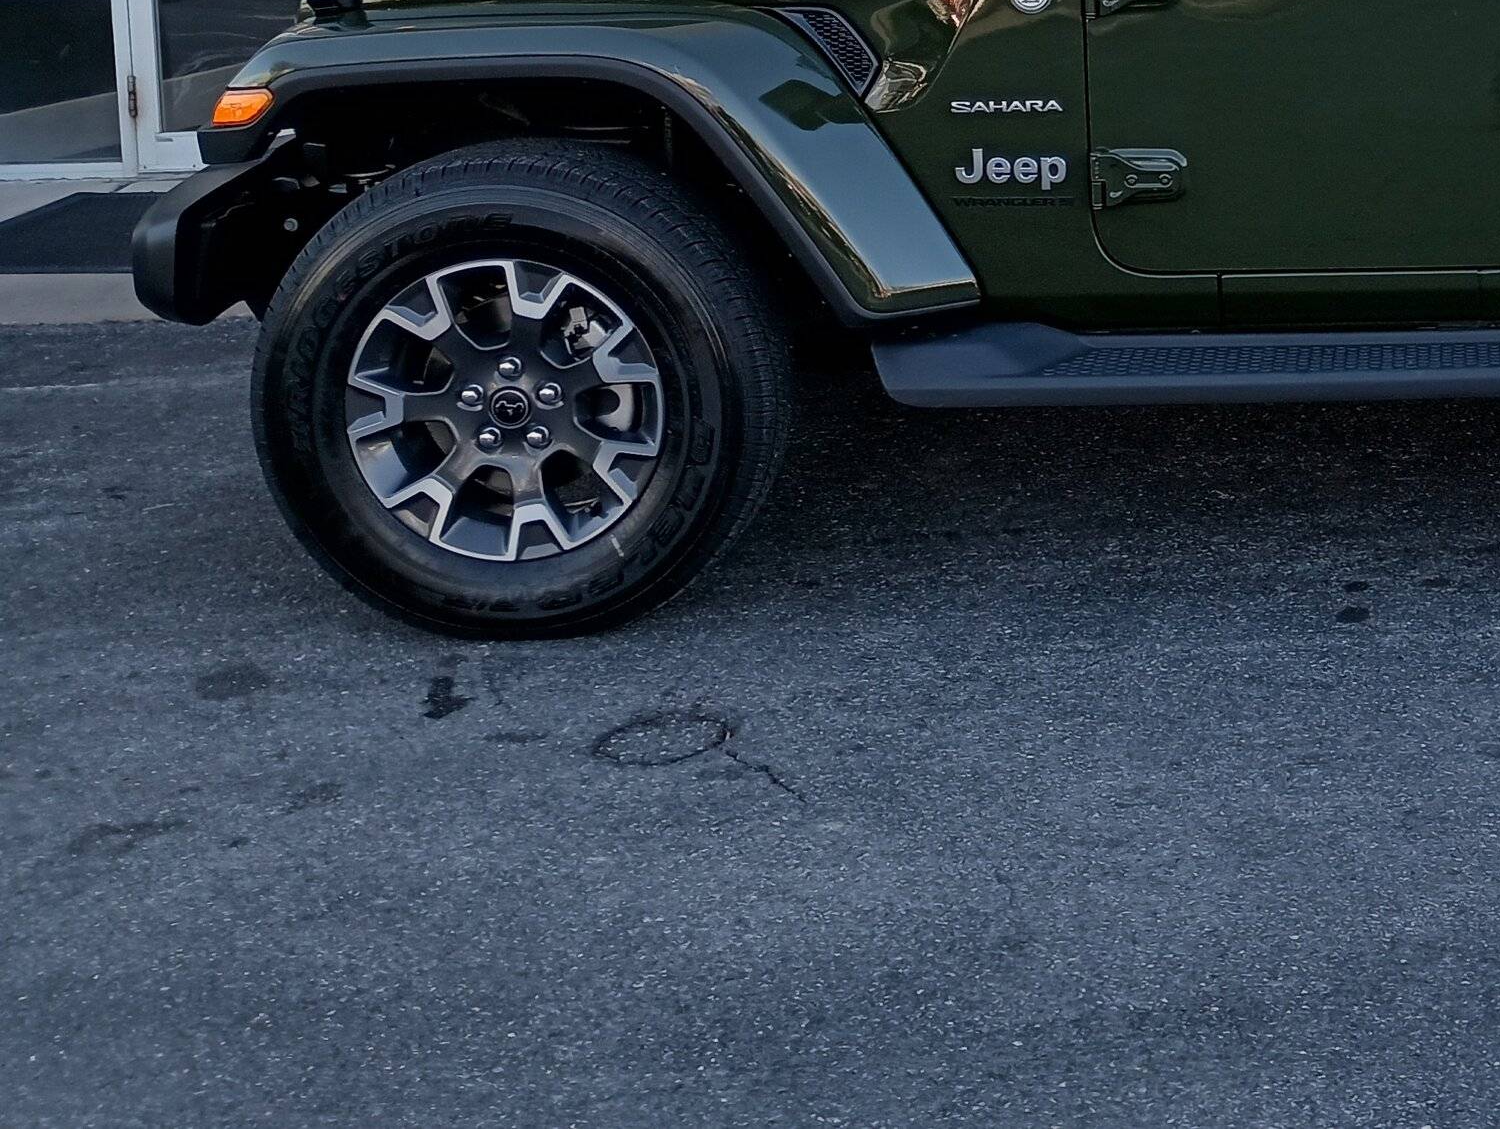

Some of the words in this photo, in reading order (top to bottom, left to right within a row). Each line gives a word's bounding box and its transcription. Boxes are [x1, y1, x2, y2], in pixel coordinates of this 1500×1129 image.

[950, 99, 1064, 114] SAHARA
[954, 147, 1068, 191] Jeep
[952, 197, 1056, 208] WRANGLER
